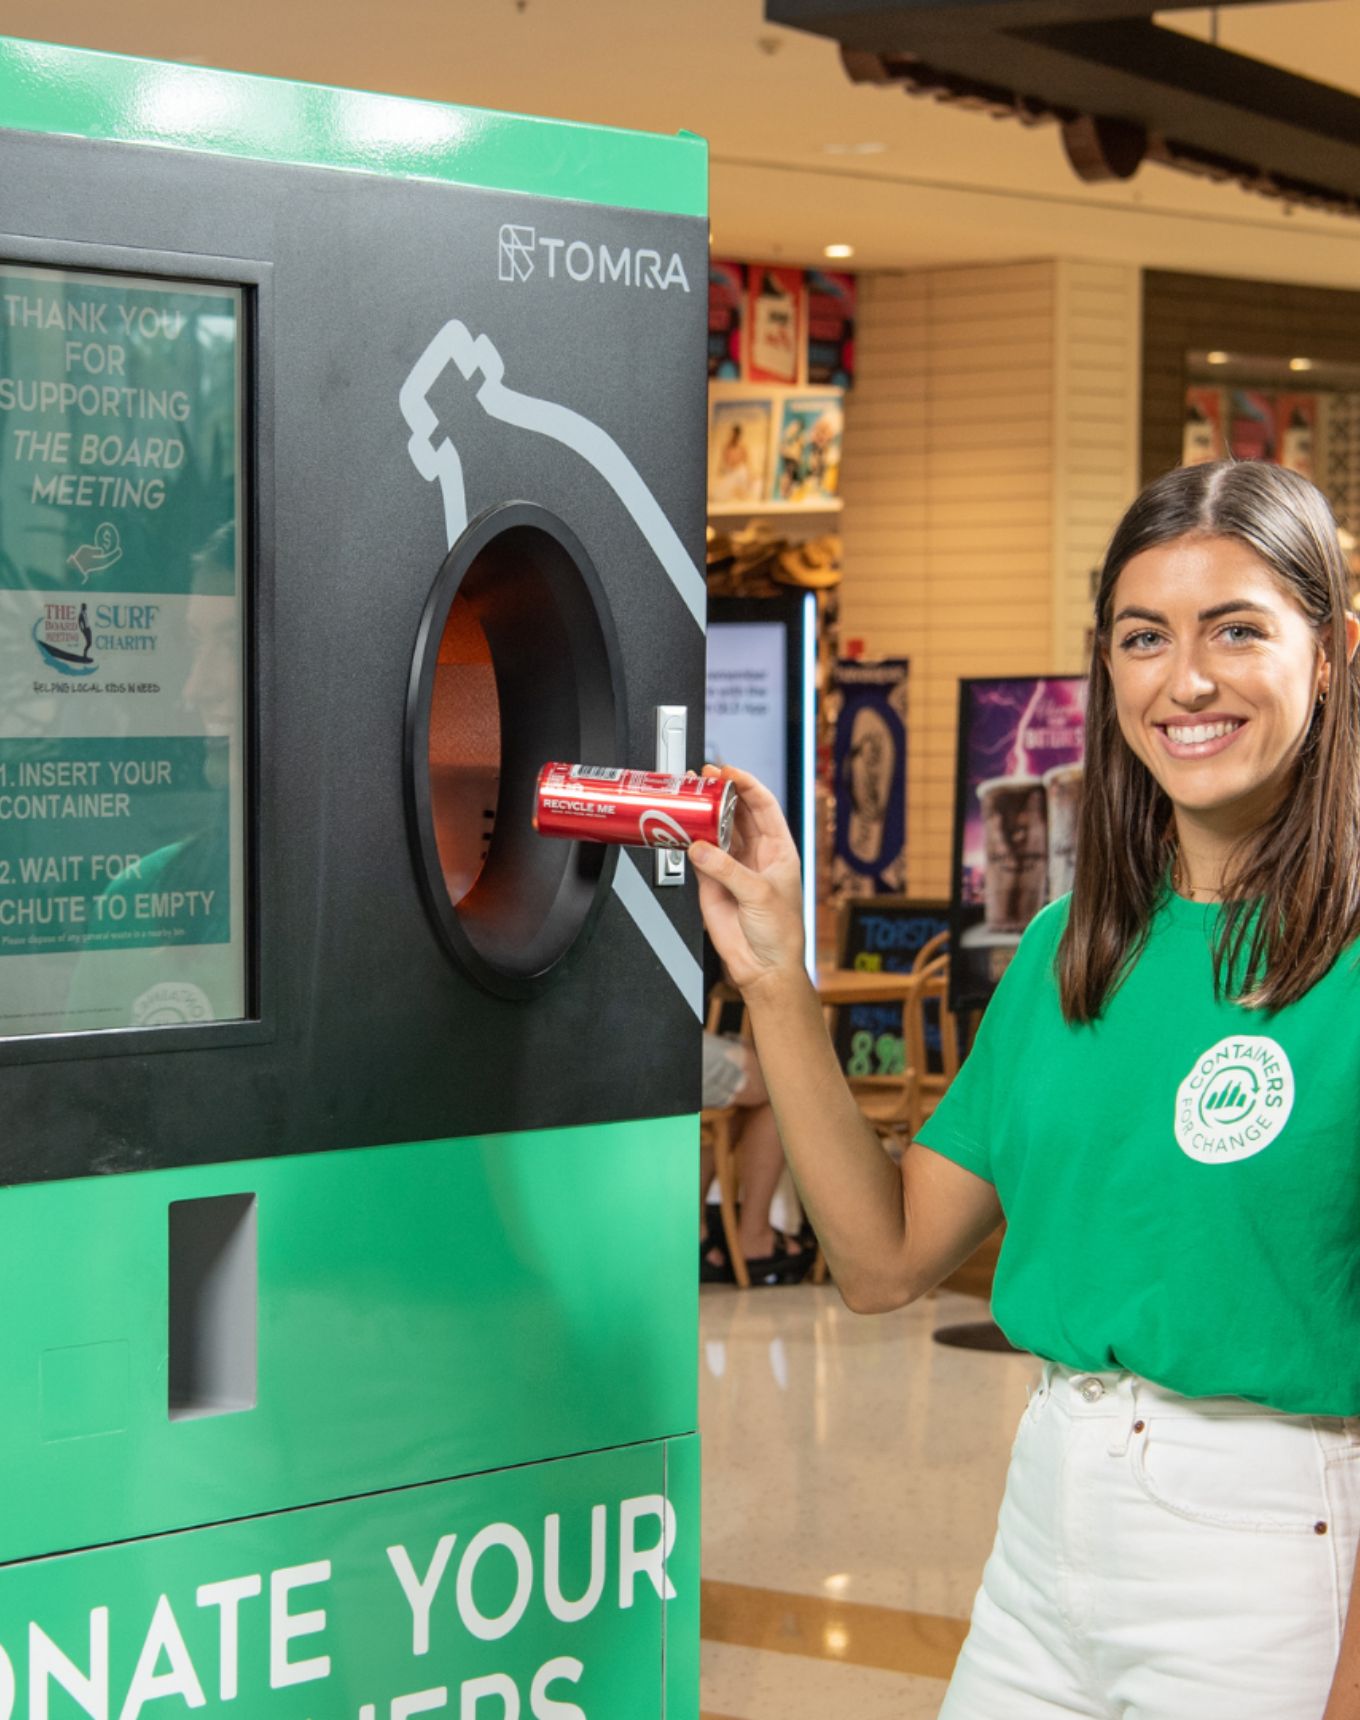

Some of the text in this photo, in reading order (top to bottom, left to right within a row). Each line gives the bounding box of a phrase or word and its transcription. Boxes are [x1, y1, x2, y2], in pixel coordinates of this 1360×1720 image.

[539, 237, 690, 293] TOMRA
[4, 295, 182, 340] THANK YOU
[65, 341, 126, 376] FOR
[0, 378, 190, 422] SUPPORTING
[14, 430, 185, 469] THE BOARD
[31, 474, 165, 510] MEETING
[44, 604, 77, 620] THE
[95, 605, 160, 629] SURF
[95, 635, 158, 650] CHARITY
[19, 761, 100, 788] INSERT
[109, 760, 172, 786] YOUR
[0, 793, 131, 820] CONTAINER
[543, 799, 594, 814] RECYCLE
[597, 804, 616, 815] ME
[0, 854, 142, 885] 2. WAIT FOR
[1, 890, 215, 925] CHUTE TO EMPTY
[1190, 1044, 1284, 1108] CONTAINERS
[1181, 1097, 1272, 1153] FOR CHANGE
[0, 1494, 677, 1720] NATE YOUR
